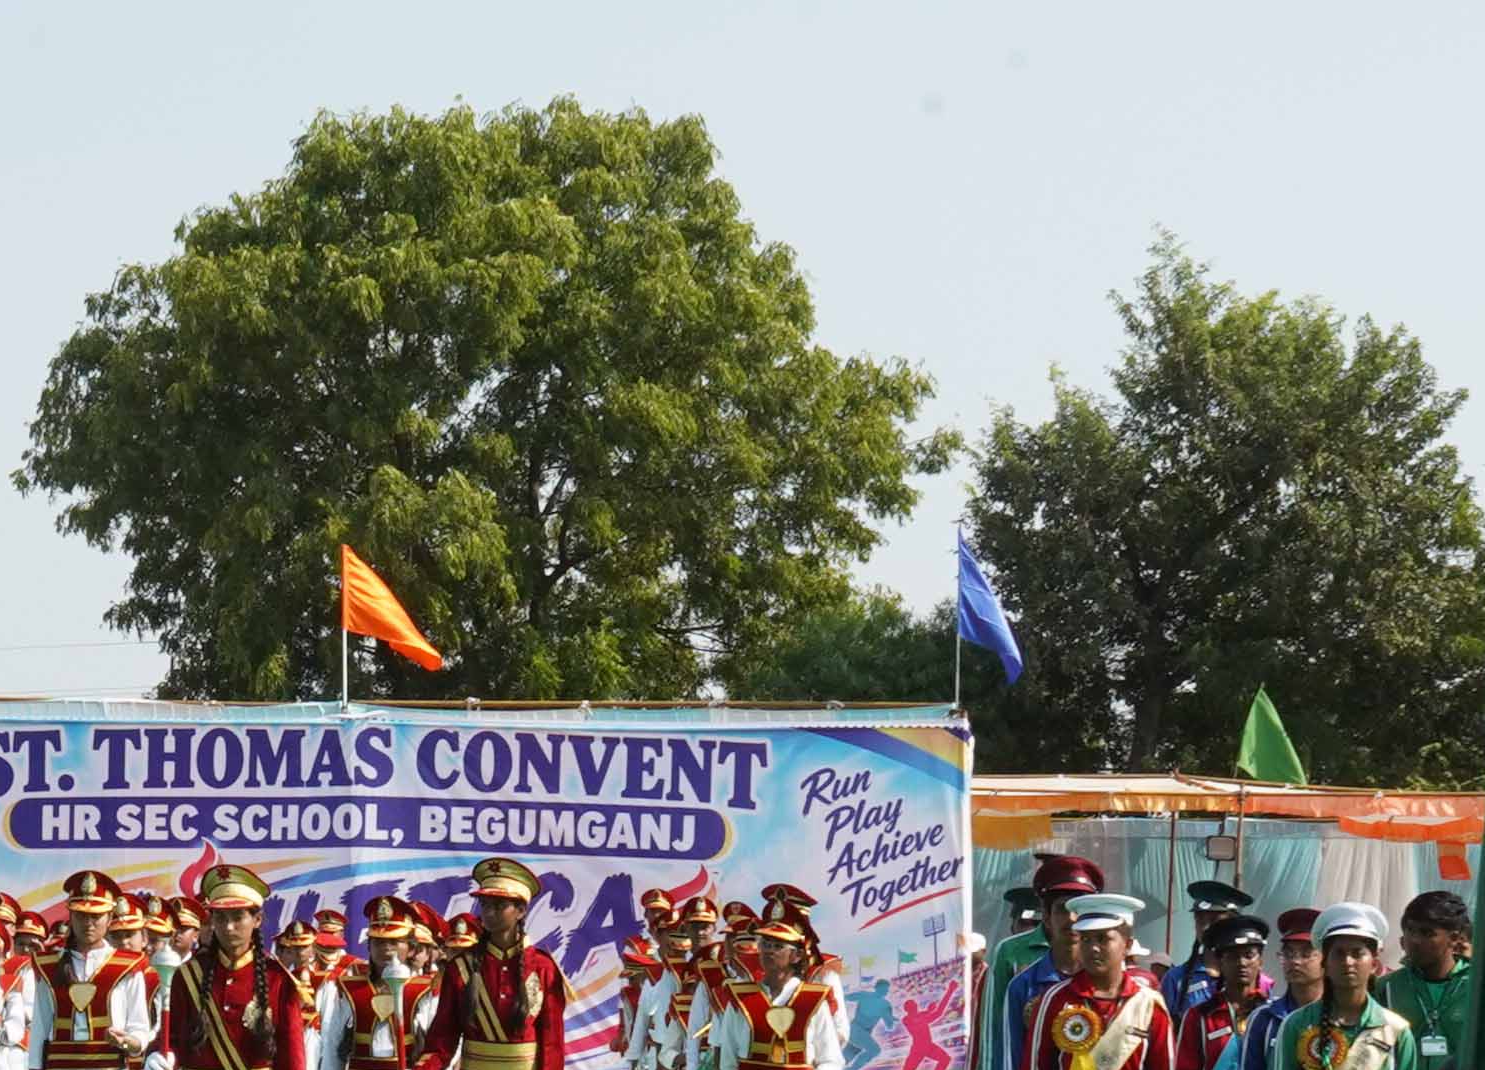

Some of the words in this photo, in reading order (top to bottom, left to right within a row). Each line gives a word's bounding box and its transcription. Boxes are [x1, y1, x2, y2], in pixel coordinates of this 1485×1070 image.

[93, 727, 395, 790] THOMAS
[416, 729, 769, 809] CONVENT
[800, 767, 871, 816] Run
[41, 804, 102, 841] HR
[116, 803, 199, 841] SEC
[212, 803, 405, 847] SCHOOL,
[419, 806, 696, 852] BEGUMGANJ
[825, 798, 903, 851] Play
[827, 823, 945, 886] Achieve
[840, 856, 965, 917] Together
